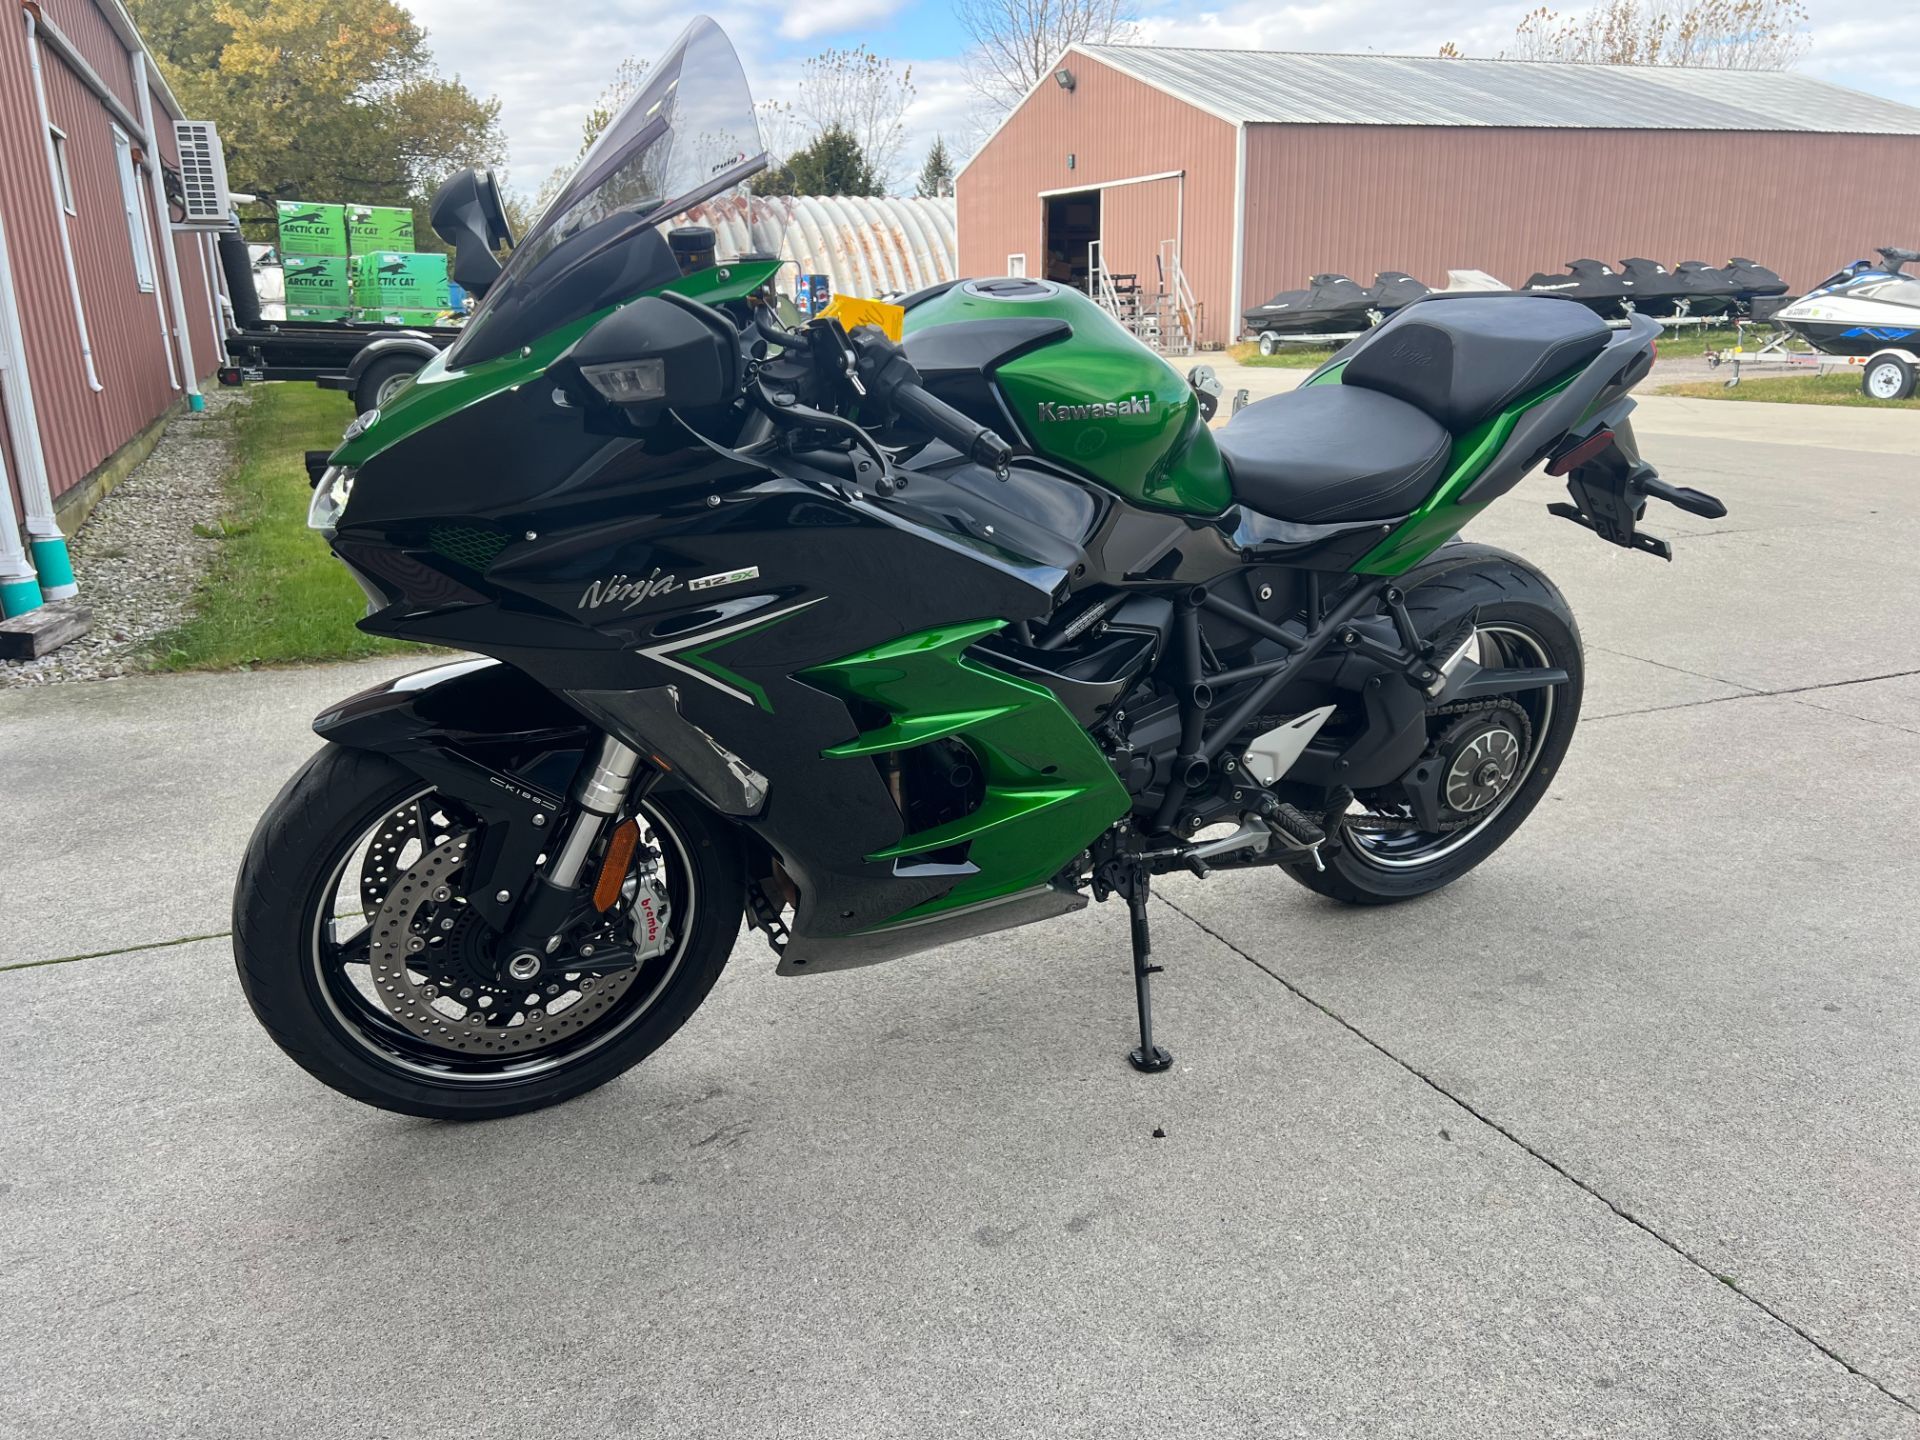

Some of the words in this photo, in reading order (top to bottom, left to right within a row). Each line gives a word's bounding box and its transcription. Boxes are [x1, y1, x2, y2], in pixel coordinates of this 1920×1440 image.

[712, 156, 737, 172] Puig
[283, 225, 312, 235] ARCTIC
[315, 227, 330, 235] CAT
[364, 227, 378, 235] CAT
[288, 278, 316, 287] ARCTIC
[319, 279, 334, 287] CAT
[400, 278, 415, 286] CAT
[1038, 395, 1150, 421] Kawasaki
[578, 567, 683, 611] Ninja
[641, 898, 658, 941] brembo
